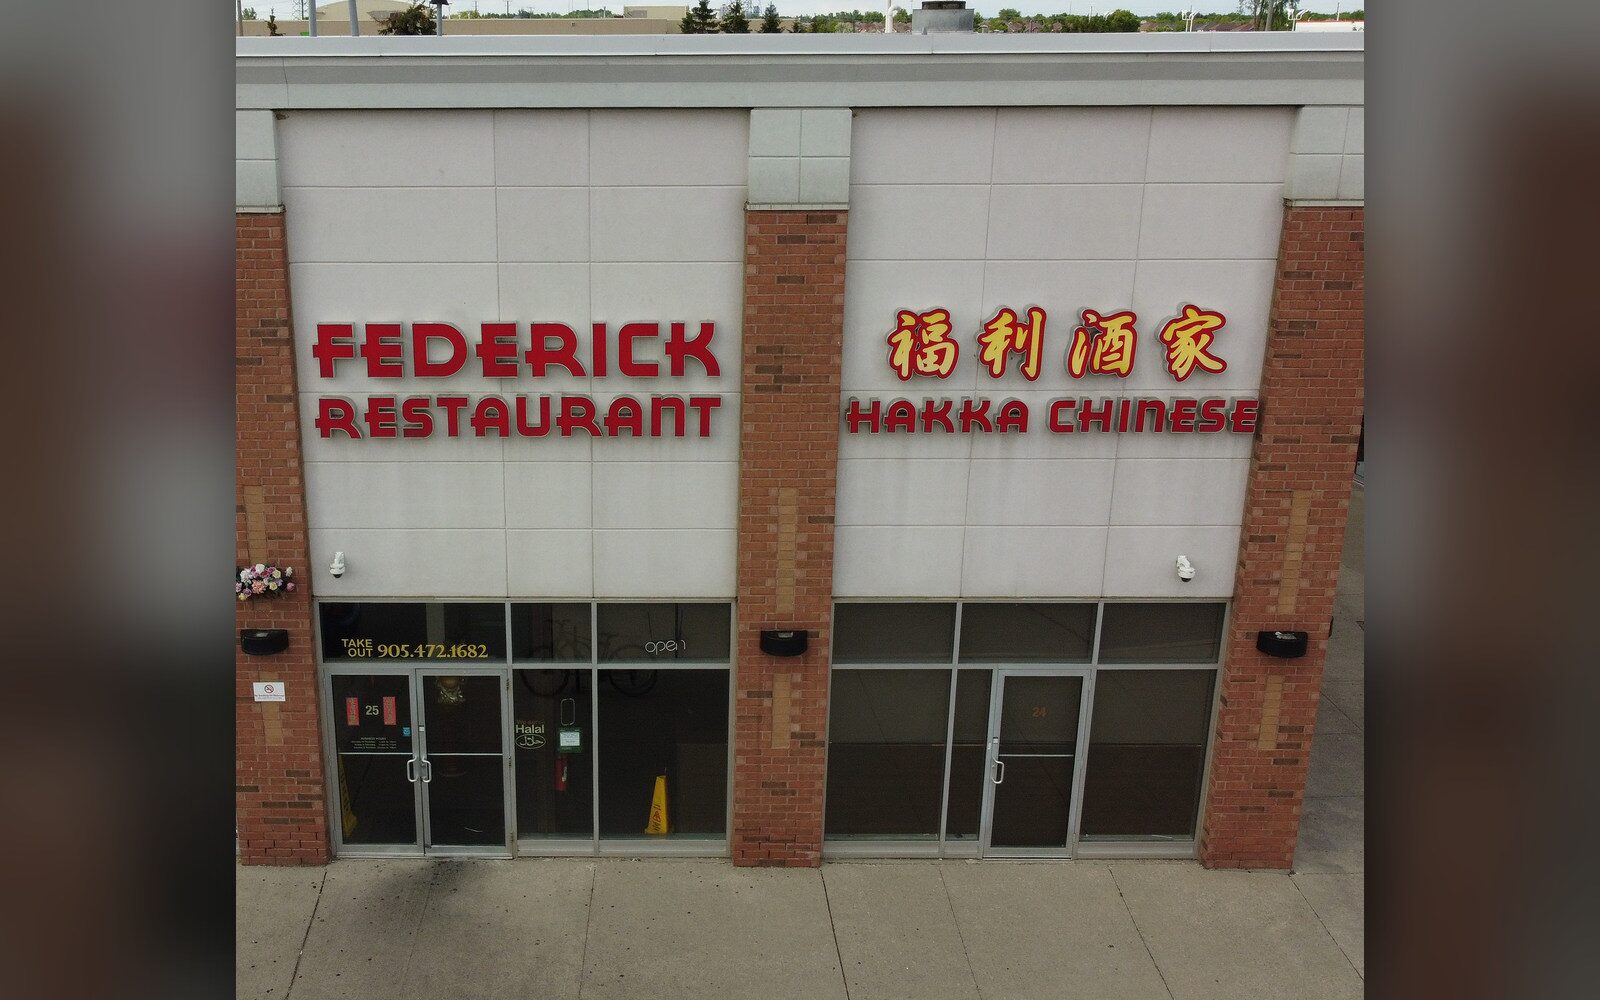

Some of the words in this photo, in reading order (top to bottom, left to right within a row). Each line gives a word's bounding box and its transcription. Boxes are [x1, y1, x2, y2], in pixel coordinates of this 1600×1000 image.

[312, 322, 721, 378] FEDERICK
[887, 304, 1228, 382] 福利酒家
[314, 396, 721, 438] RESTAURANT
[847, 399, 1029, 433] HAKKA
[1049, 399, 1260, 433] CHINESE
[341, 638, 373, 648] TAKE
[347, 648, 374, 658] OUT
[377, 644, 489, 658] 905.472.1682
[365, 705, 380, 716] 25
[515, 724, 545, 734] Halal
